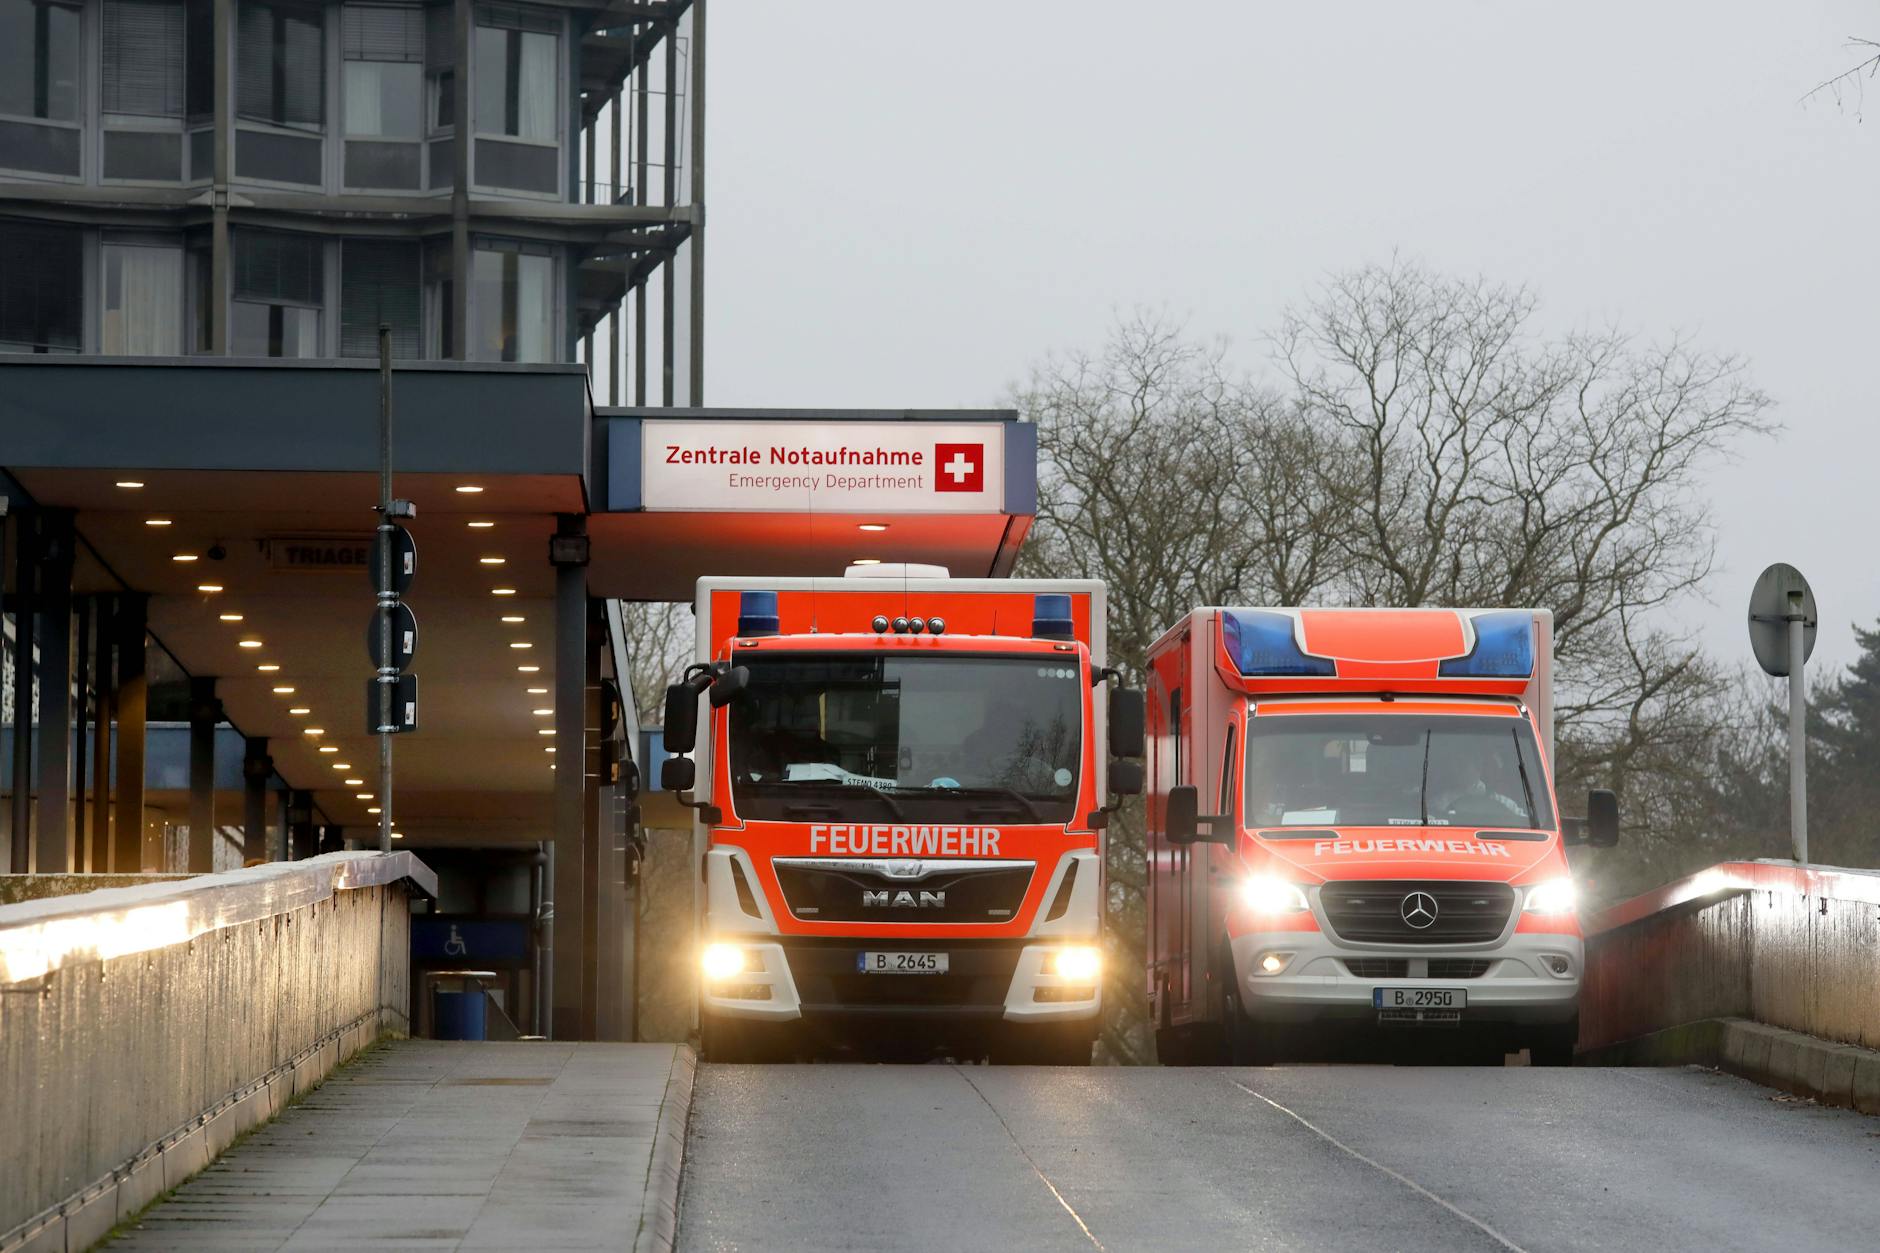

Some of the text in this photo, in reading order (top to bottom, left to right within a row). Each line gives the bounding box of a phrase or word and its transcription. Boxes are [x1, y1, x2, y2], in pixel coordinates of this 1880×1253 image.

[666, 445, 924, 466] Zentrale Notaufnahme
[729, 473, 924, 491] Emergency Department
[286, 547, 368, 565] TRIAGE
[810, 825, 1001, 856] FEUERWEHR
[1314, 839, 1512, 858] FEUERWEHR
[863, 890, 946, 908] MAN
[877, 954, 937, 969] B 2645
[1394, 991, 1453, 1006] B 2950
